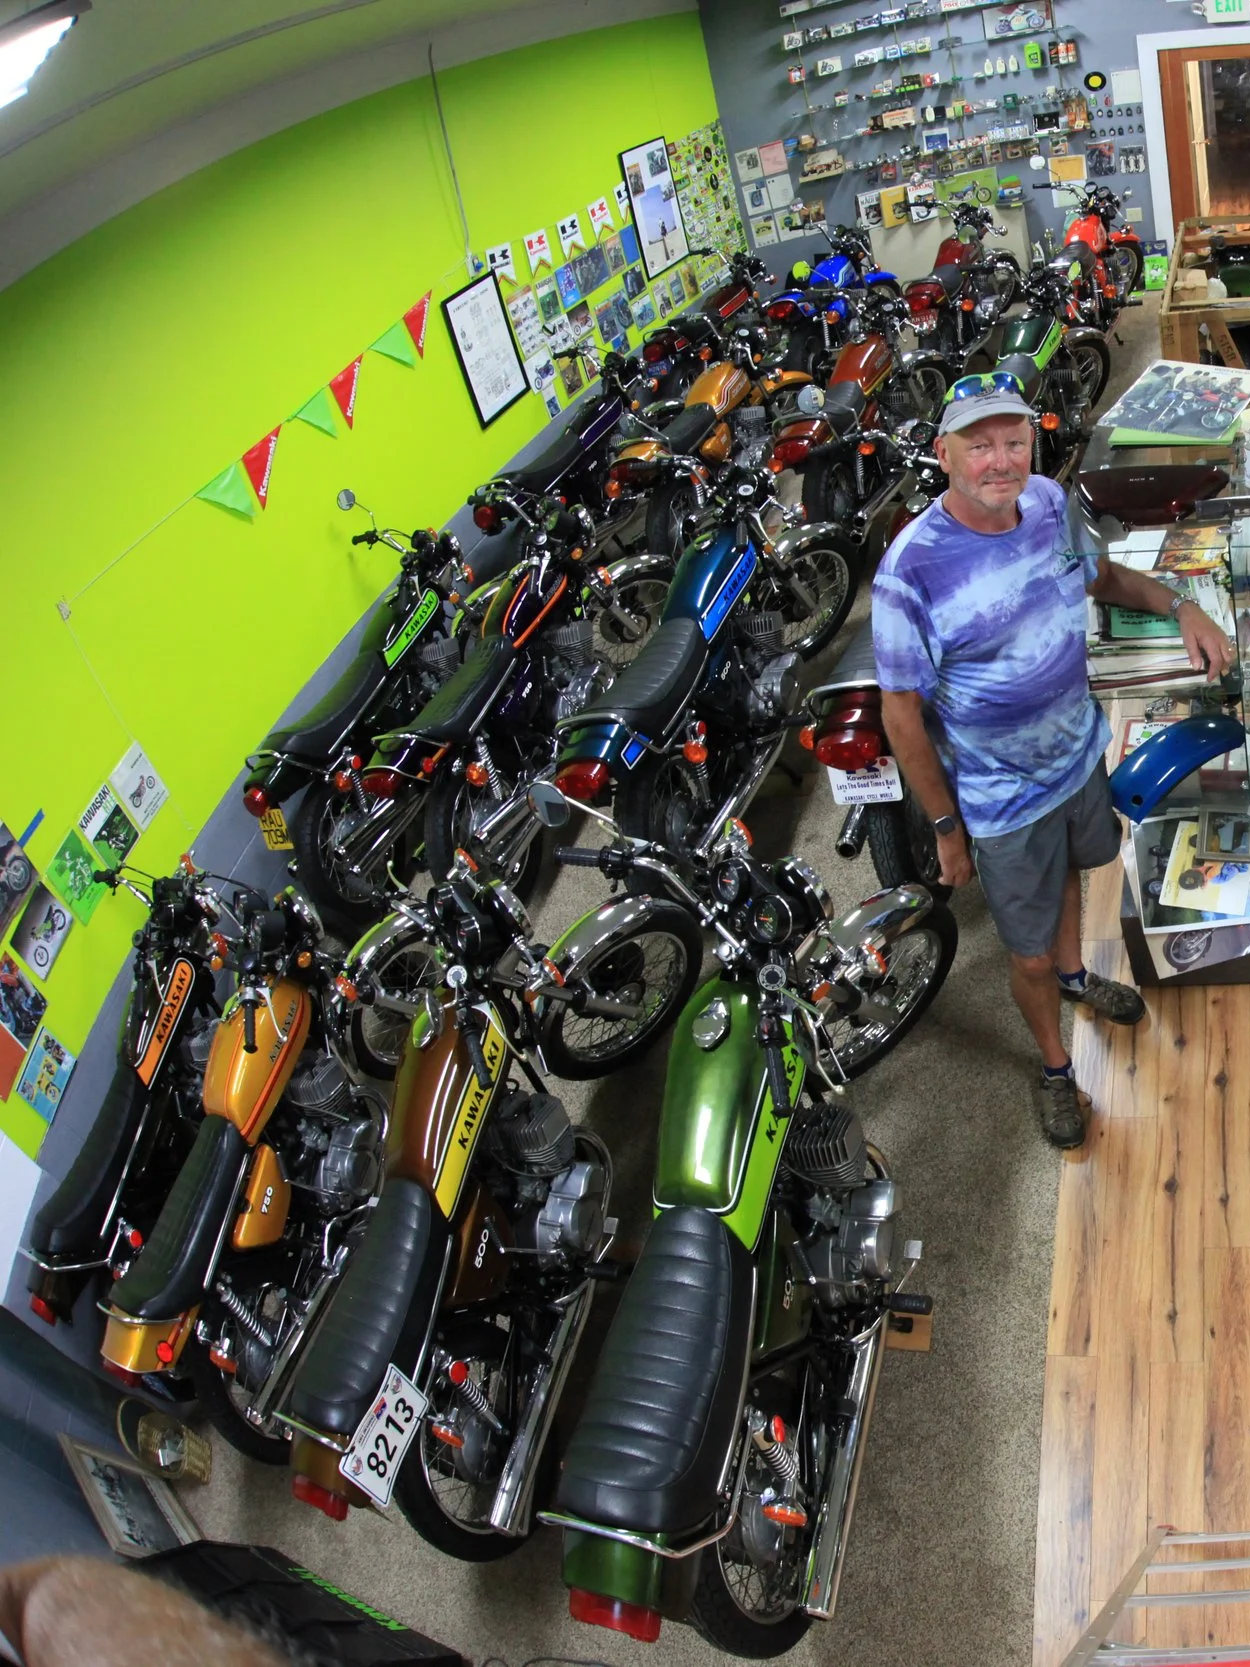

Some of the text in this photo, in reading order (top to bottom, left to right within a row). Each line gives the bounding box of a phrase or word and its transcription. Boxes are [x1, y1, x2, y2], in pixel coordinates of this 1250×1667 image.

[347, 362, 360, 417] Kawasaki
[258, 435, 277, 496] Kawasaki
[724, 551, 754, 602] KAWASAKI
[404, 595, 435, 639] KAWASAKI
[846, 773, 881, 781] Kawasaki
[79, 784, 111, 832] KAWASAKI
[261, 810, 283, 829] RAU
[156, 968, 188, 1044] KAWASAKI
[457, 1041, 499, 1150] KAWAKI
[261, 1186, 273, 1213] 750
[474, 1229, 489, 1269] 500
[367, 1397, 414, 1478] 8213
[288, 1568, 409, 1630] Kawasaki
